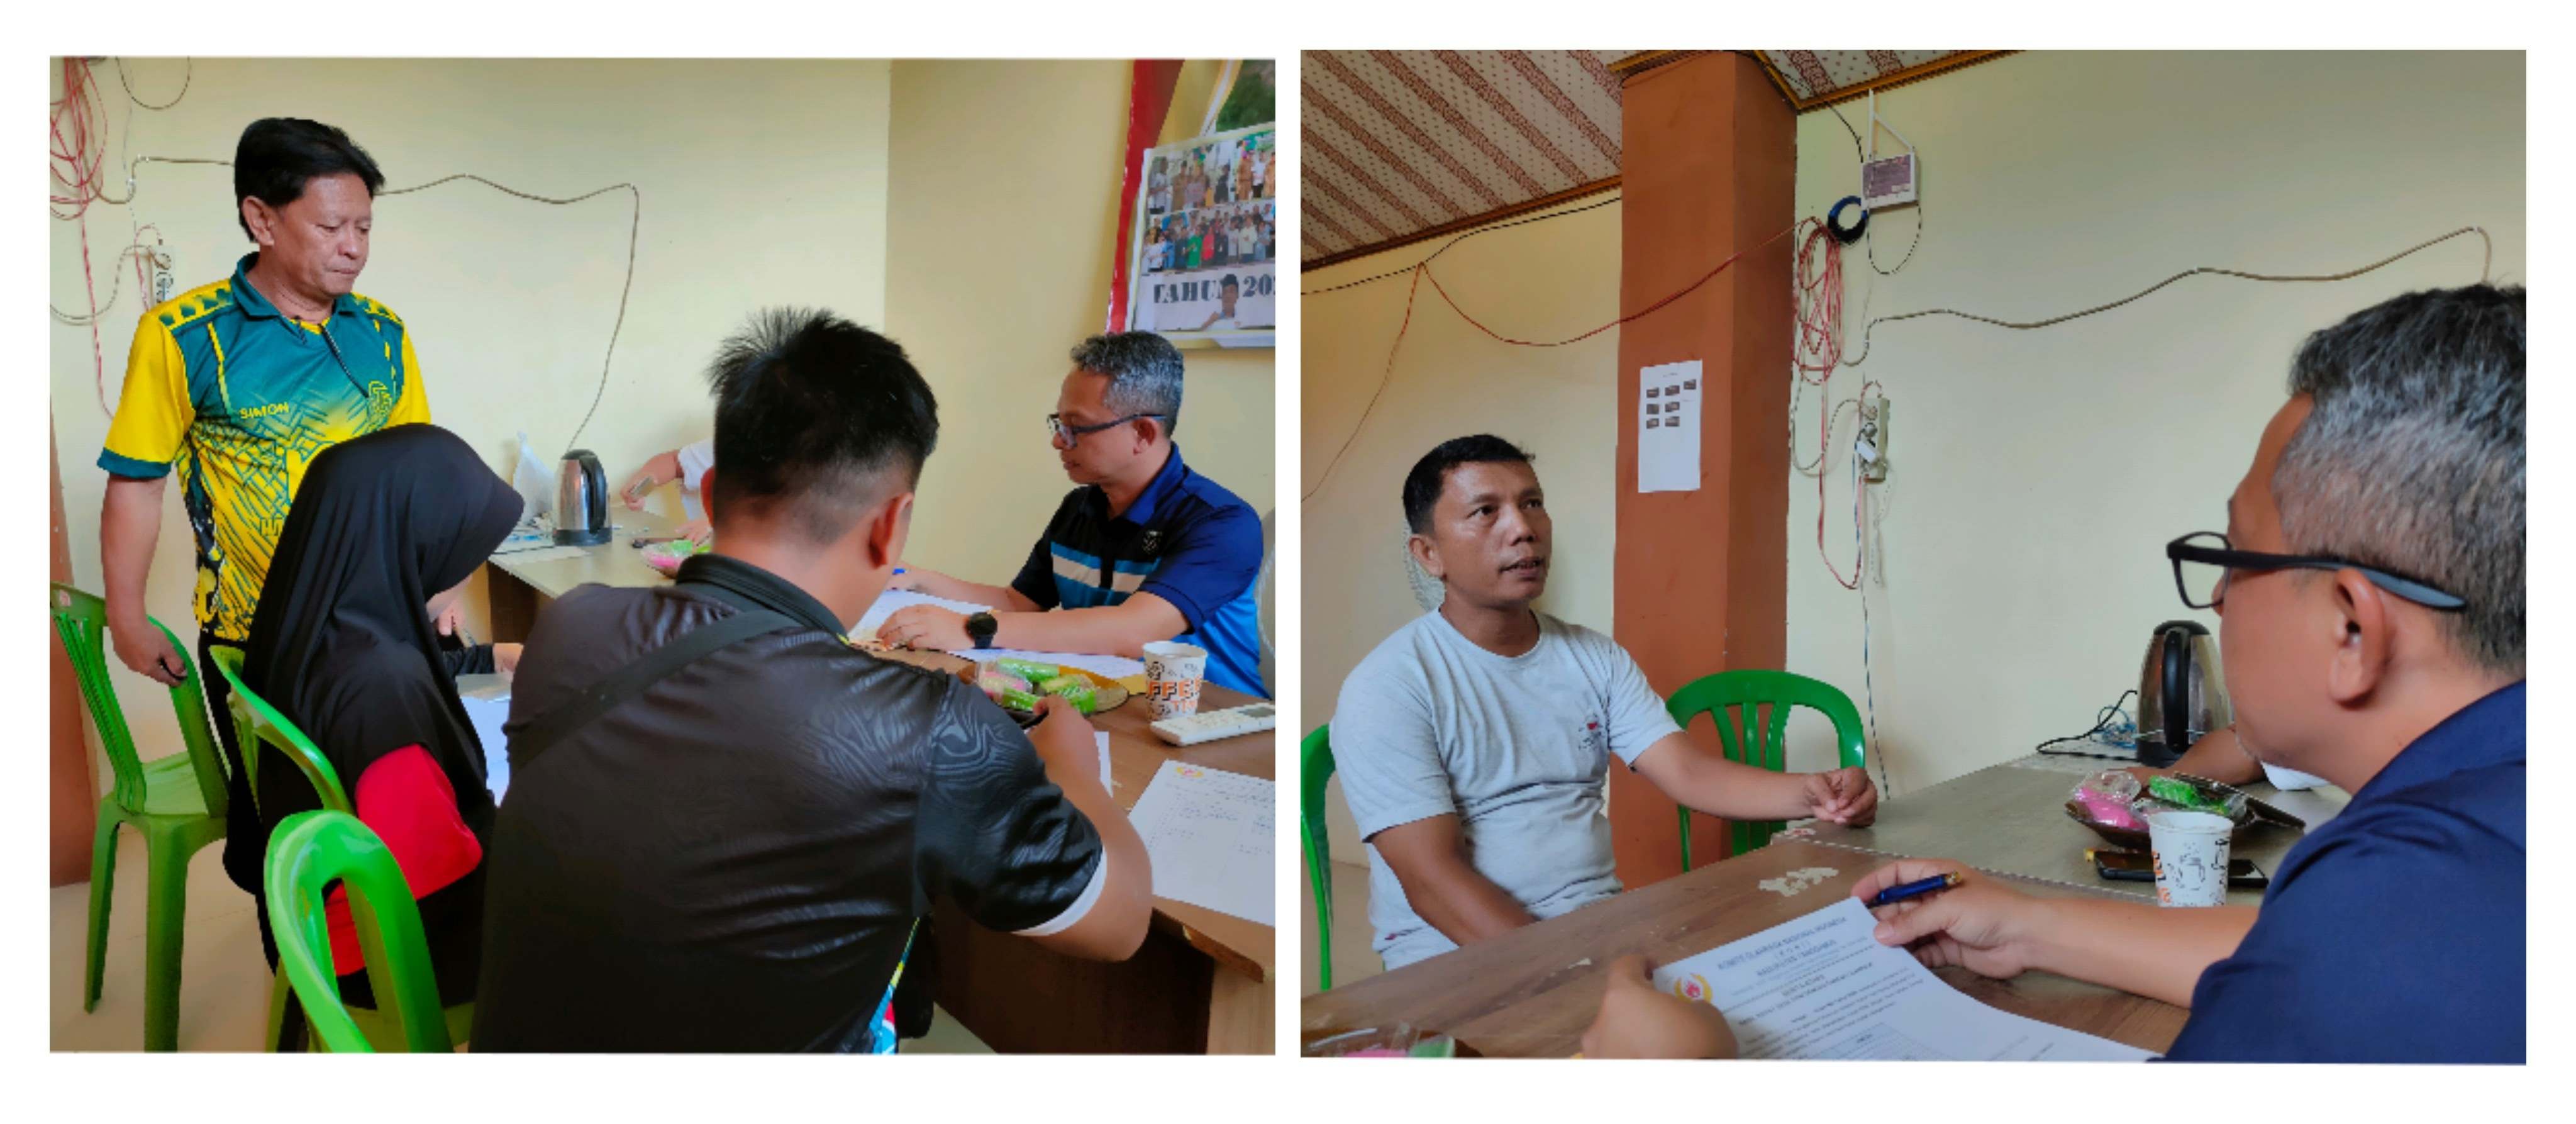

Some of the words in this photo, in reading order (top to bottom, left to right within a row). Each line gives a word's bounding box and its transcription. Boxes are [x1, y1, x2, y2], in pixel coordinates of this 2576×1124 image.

[1154, 279, 1223, 303] TAHU
[1242, 274, 1275, 297] 20
[240, 402, 289, 419] SIMON
